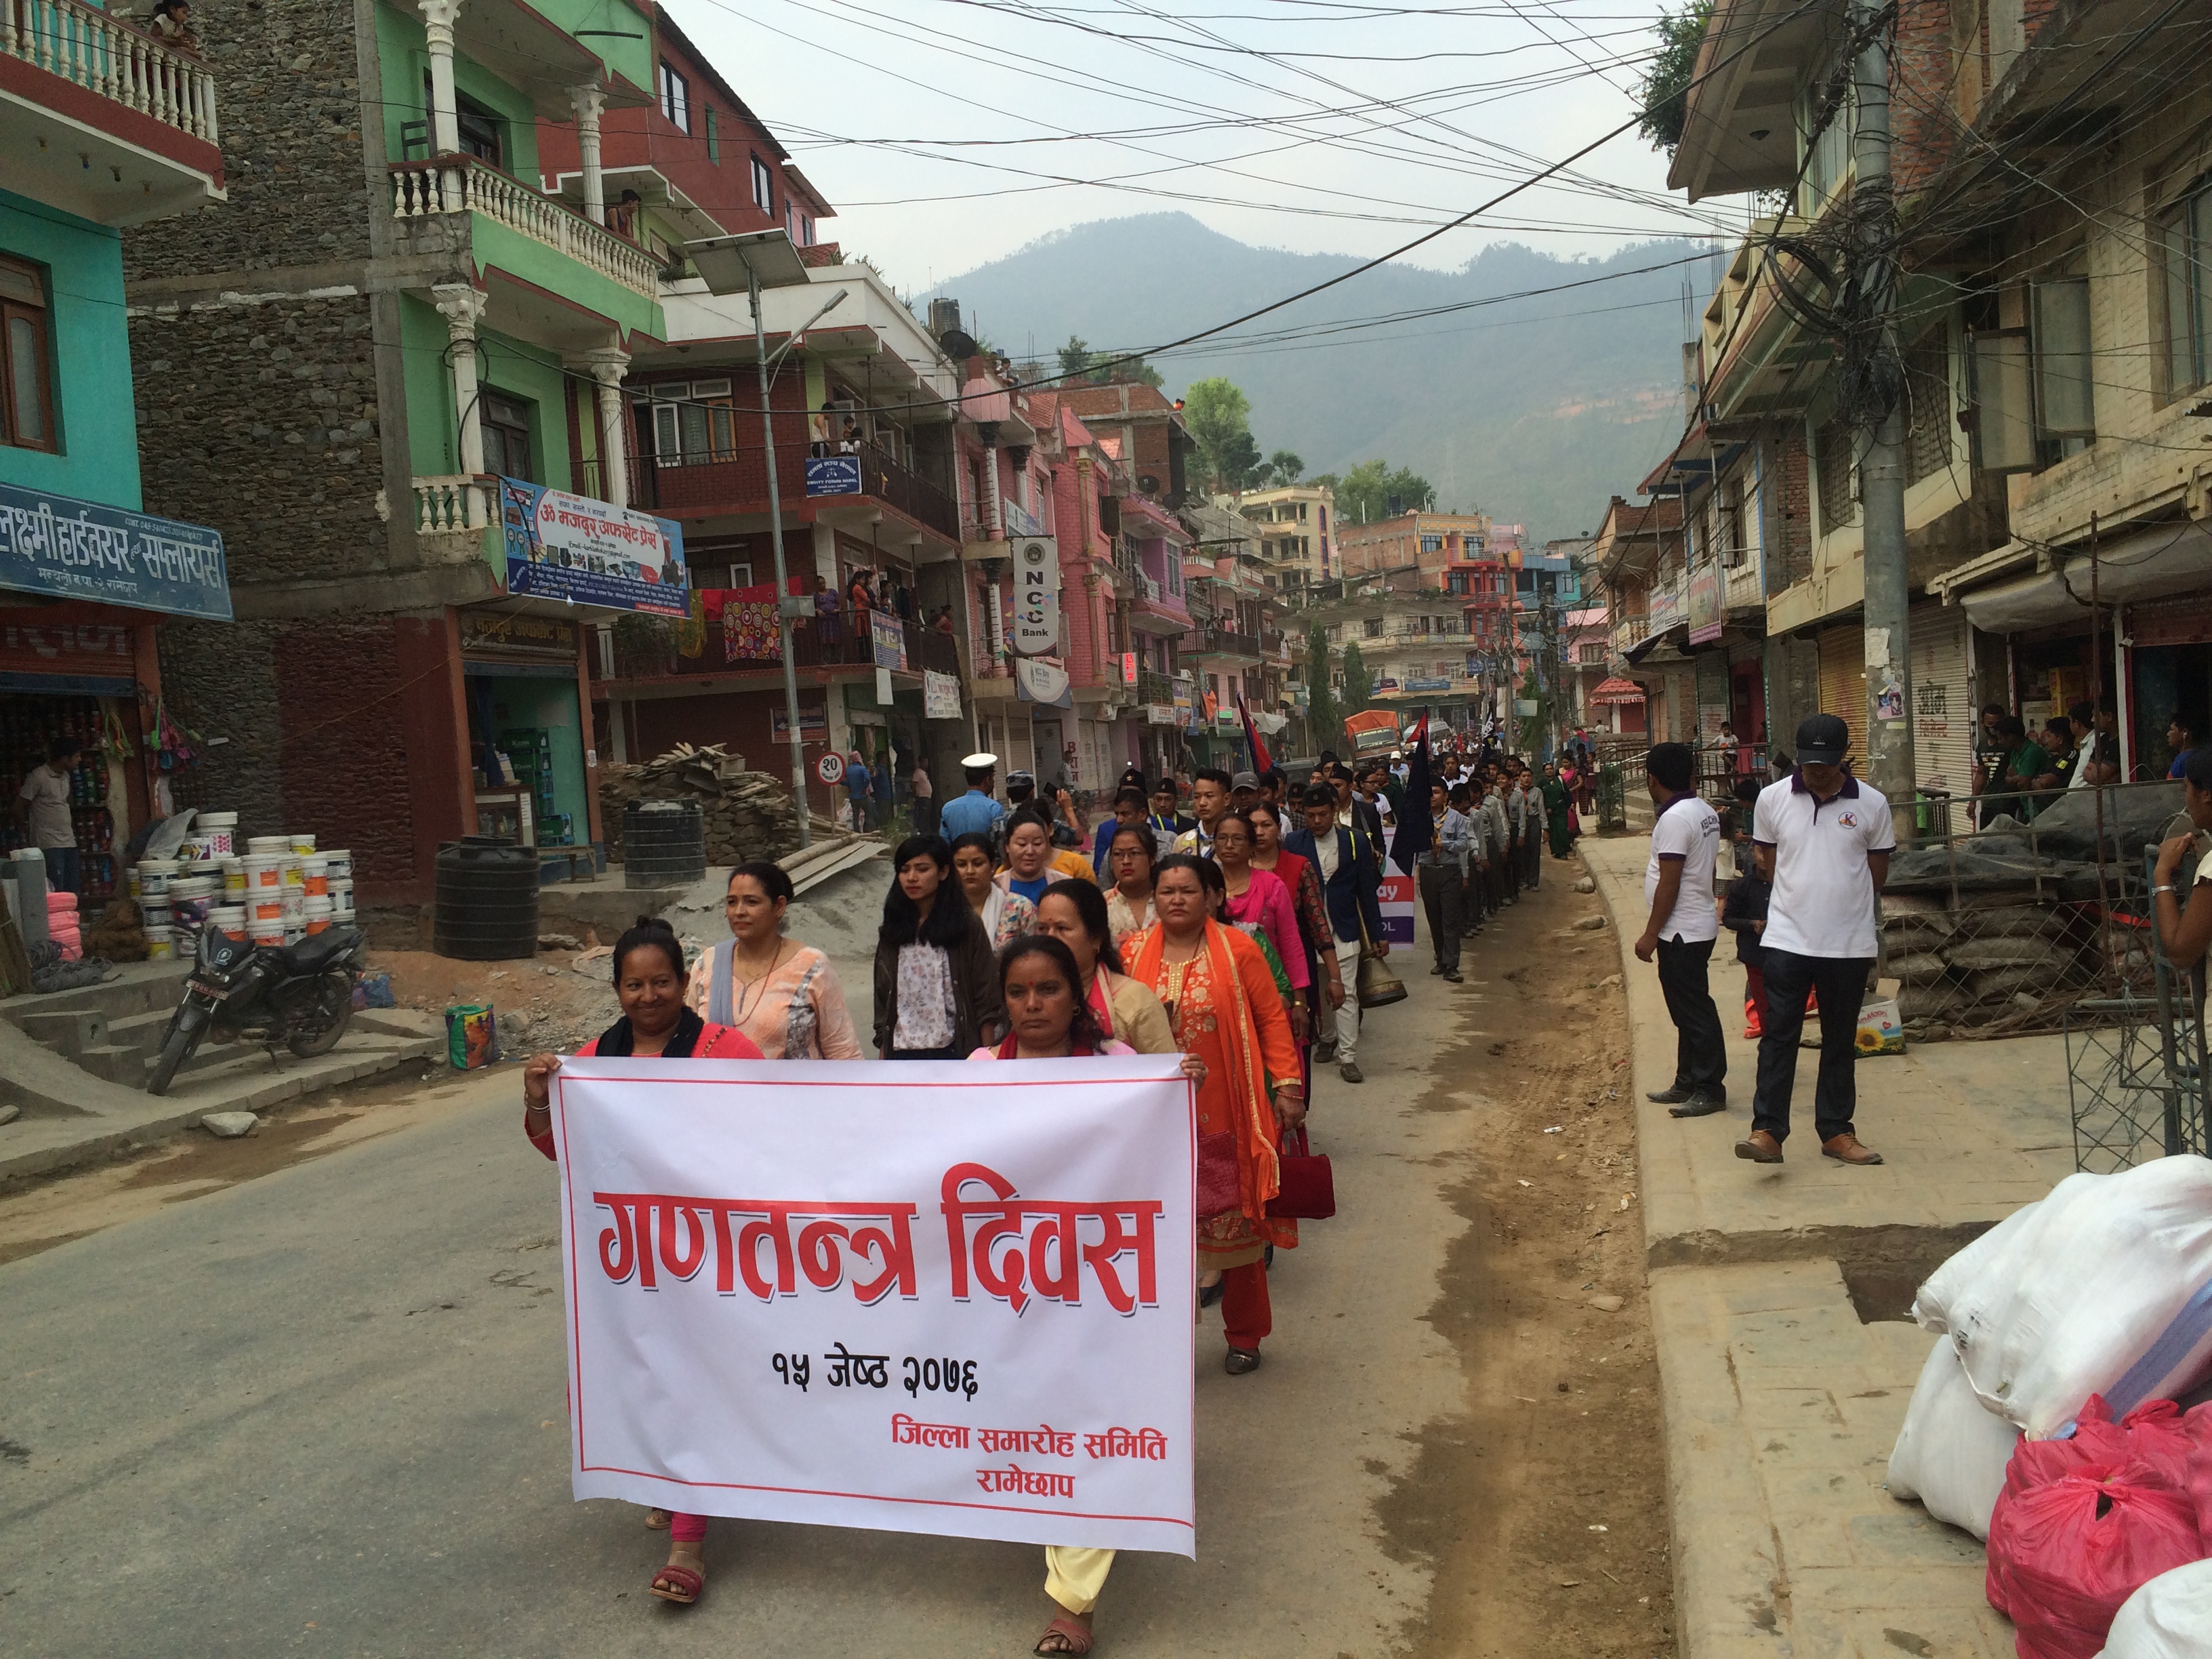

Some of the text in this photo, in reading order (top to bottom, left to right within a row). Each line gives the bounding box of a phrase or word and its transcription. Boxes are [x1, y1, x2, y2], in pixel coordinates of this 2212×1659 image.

[1022, 628, 1048, 637] Bank
[593, 1162, 1165, 1318] गणतन्त्र दिवस
[772, 1342, 979, 1402] १५ जेष्ठ २०७६
[891, 1413, 1168, 1461] जिल्ला समारोह समिति
[976, 1463, 1076, 1498] रामेछाप
